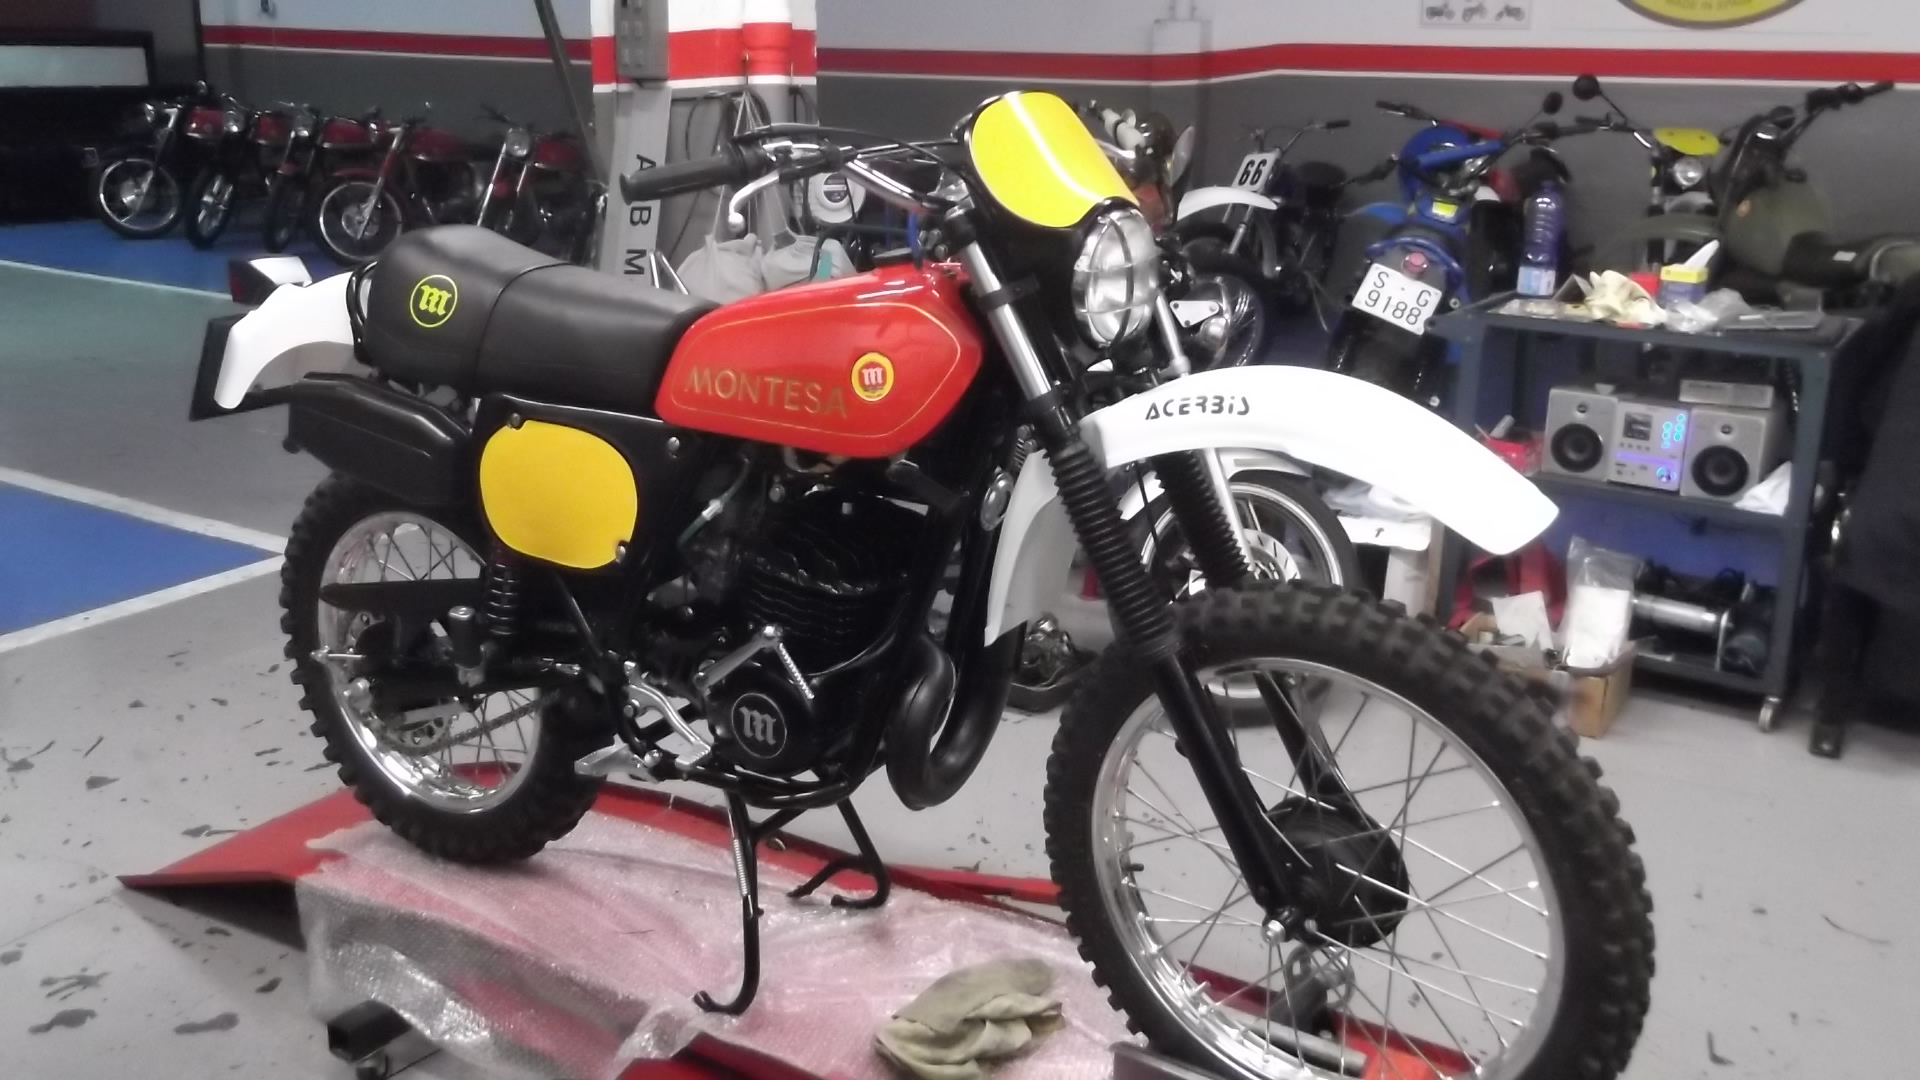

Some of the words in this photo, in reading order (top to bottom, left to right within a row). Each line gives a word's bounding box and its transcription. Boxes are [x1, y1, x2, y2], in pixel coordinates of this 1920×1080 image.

[1238, 158, 1267, 186] 66
[1365, 289, 1421, 325] 9188
[684, 365, 847, 419] MONTESA
